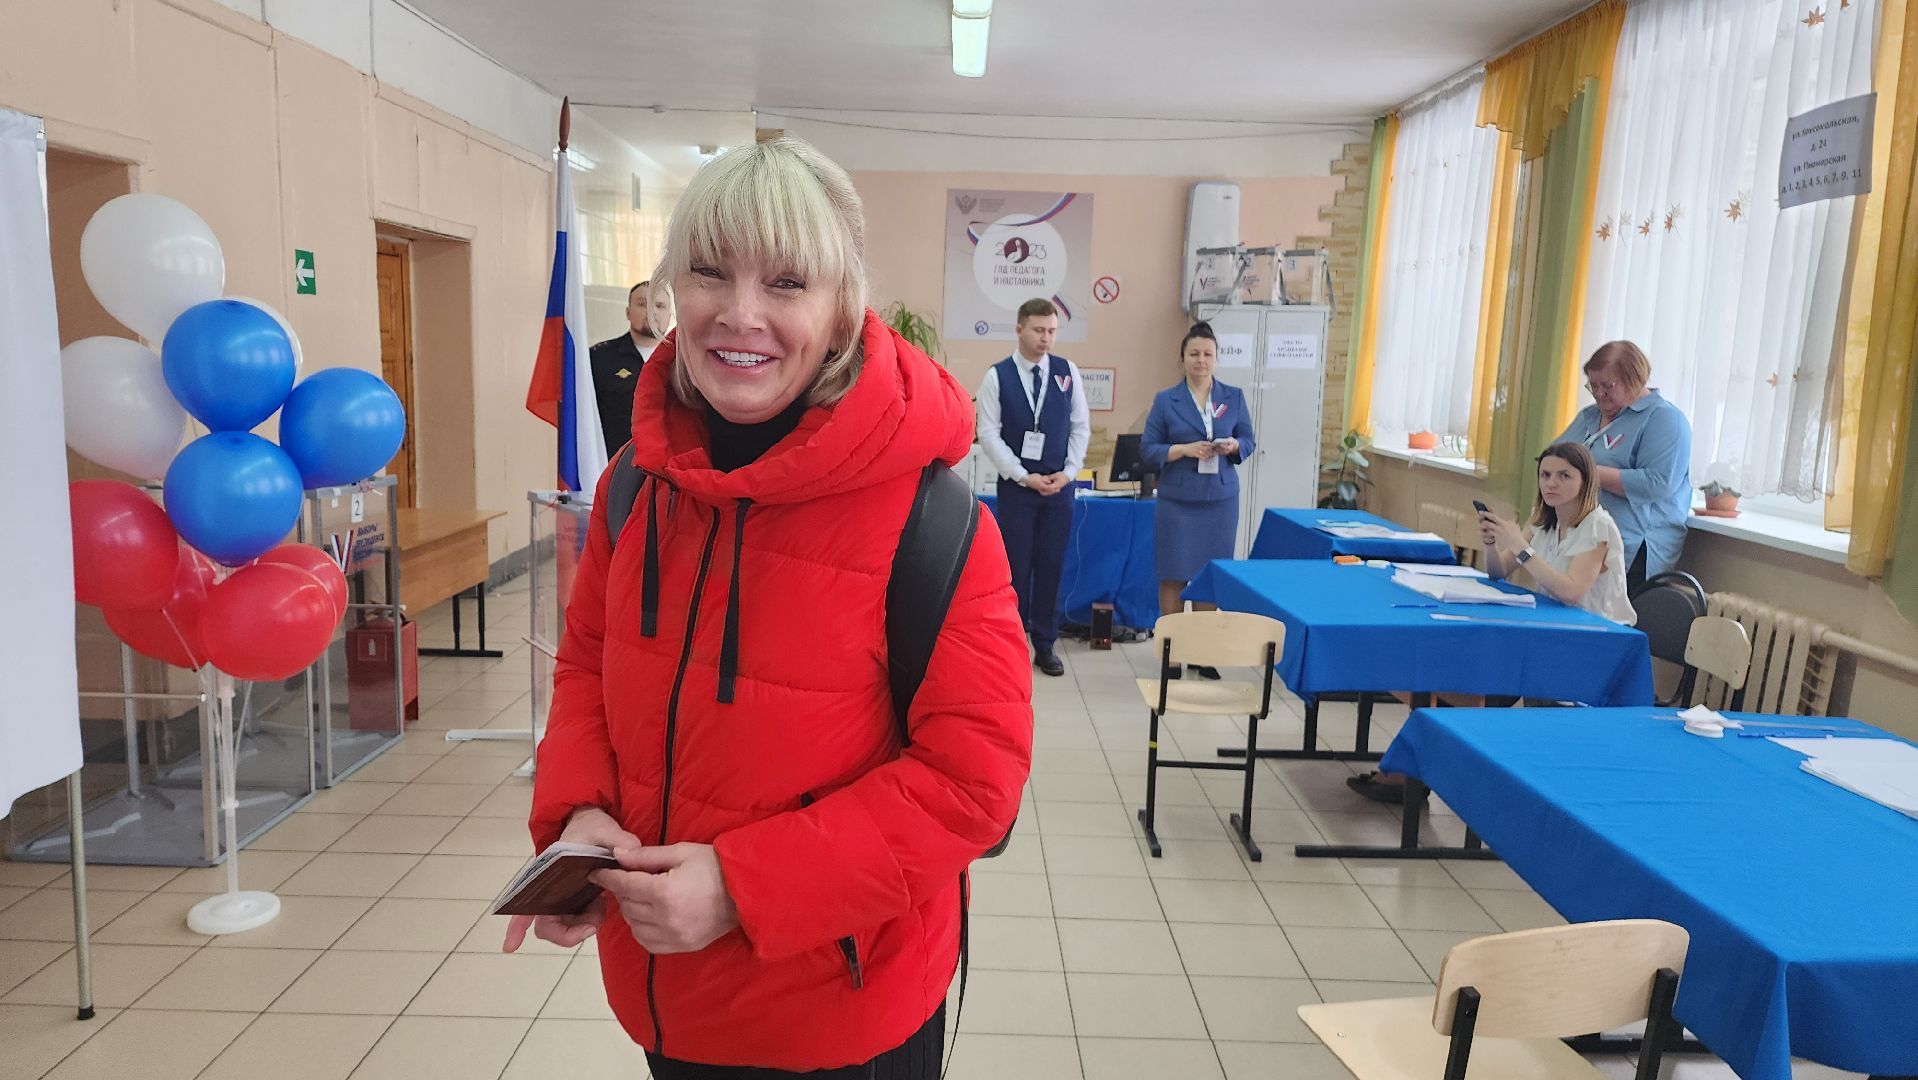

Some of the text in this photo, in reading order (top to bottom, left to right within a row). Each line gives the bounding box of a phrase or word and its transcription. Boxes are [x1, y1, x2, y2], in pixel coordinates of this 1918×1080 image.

[1803, 154, 1847, 170] Пионерская
[1852, 168, 1862, 178] 11
[993, 265, 1045, 275] ГОД ПЕДАГОГА
[993, 277, 1045, 287] И НАСТАВНИКА
[354, 499, 361, 516] 2
